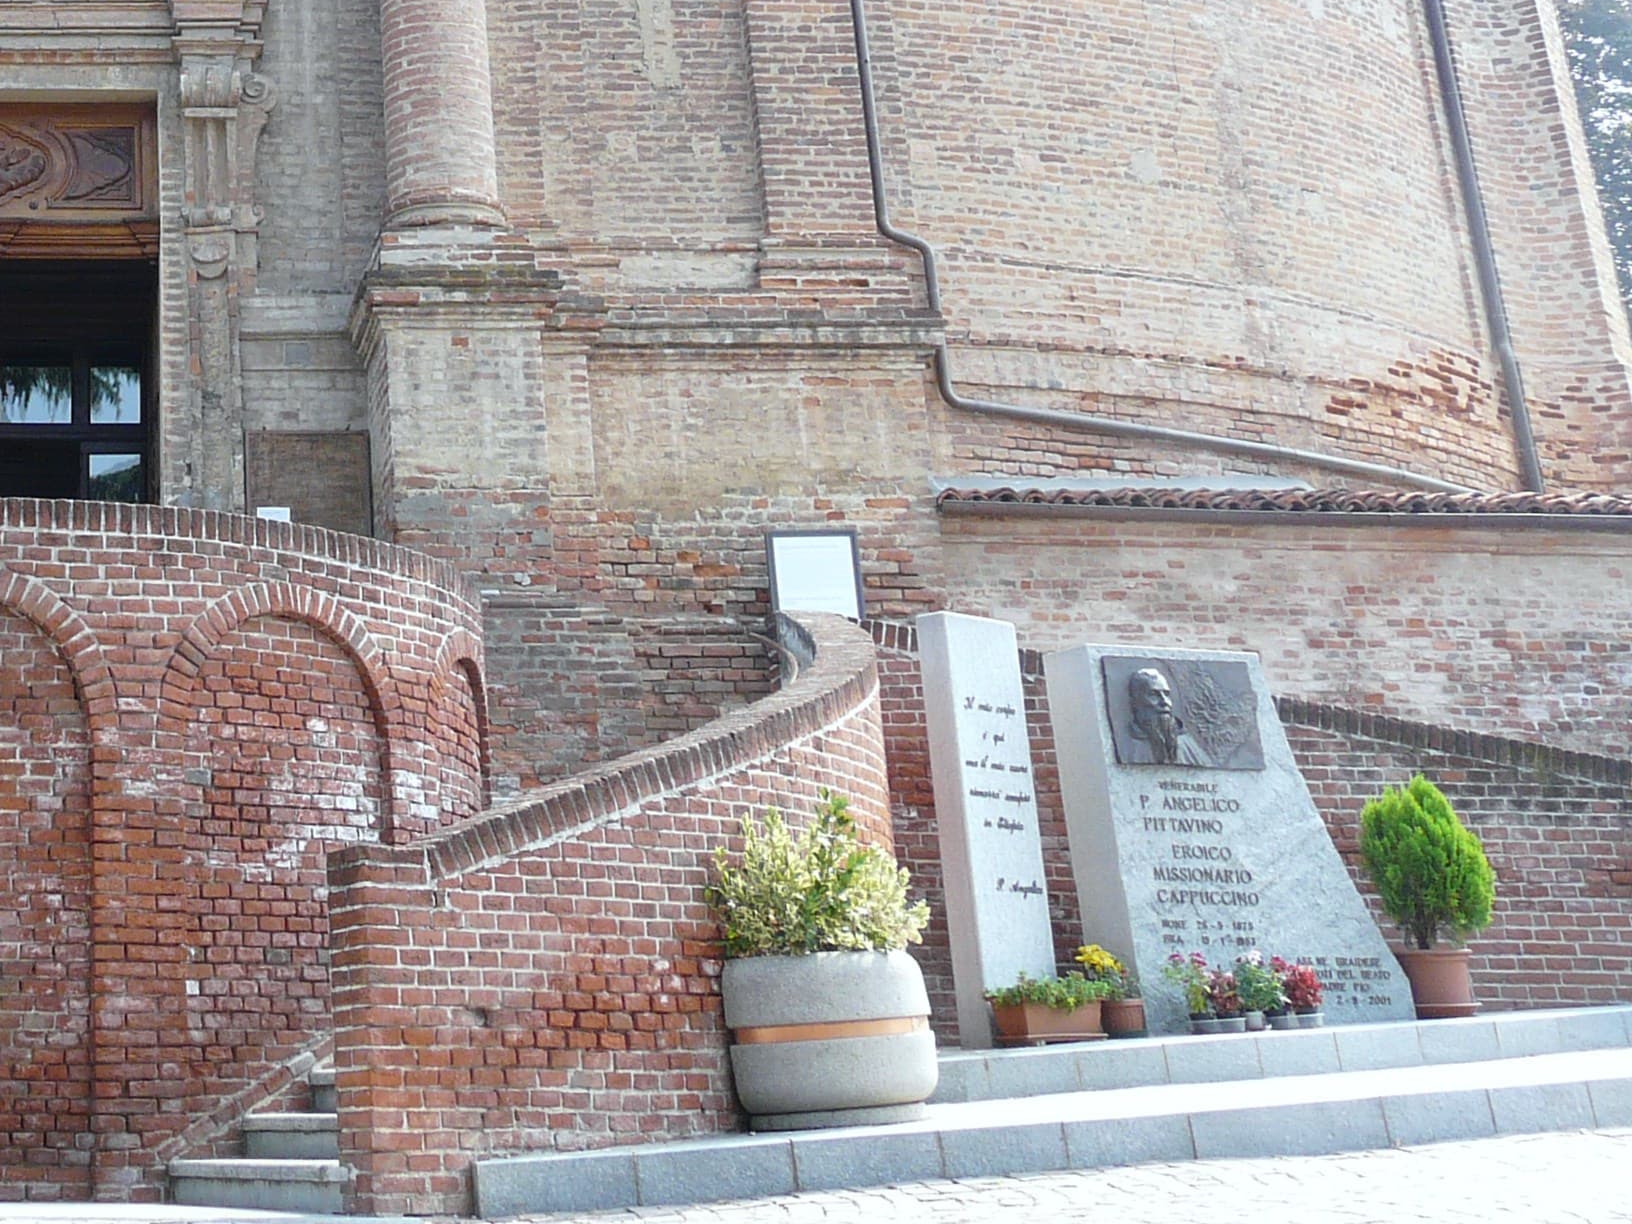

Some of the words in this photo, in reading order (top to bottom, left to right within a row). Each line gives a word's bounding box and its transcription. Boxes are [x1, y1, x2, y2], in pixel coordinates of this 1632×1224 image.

[1158, 781, 1218, 793] VENERABILE
[1162, 796, 1240, 813] ANGELICO
[1143, 817, 1223, 834] PITTAVINO
[1172, 844, 1233, 861] EROICO
[1153, 867, 1252, 884] MISSIONARIO
[1156, 889, 1260, 907] CAPPUCCINO
